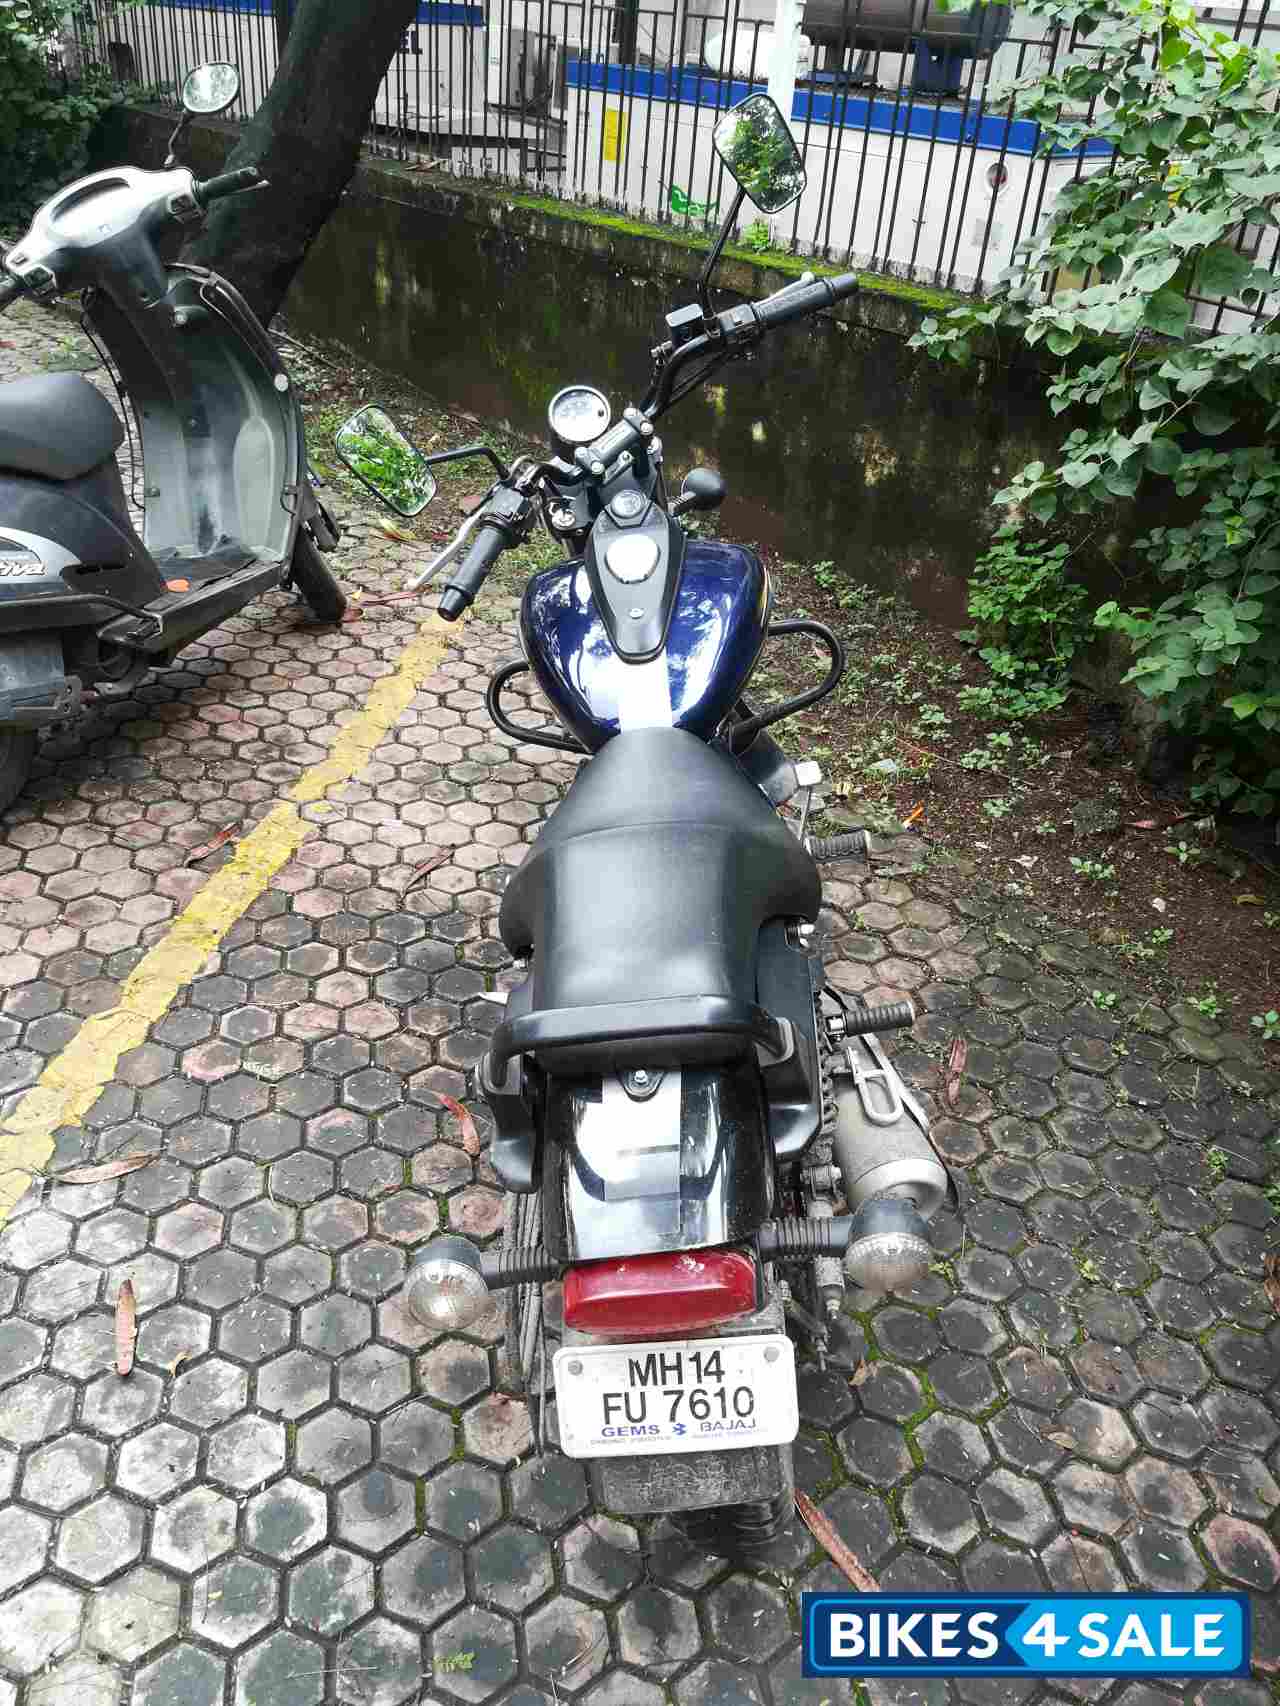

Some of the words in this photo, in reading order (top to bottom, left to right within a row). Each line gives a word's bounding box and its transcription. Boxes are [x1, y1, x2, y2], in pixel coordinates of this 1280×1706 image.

[603, 1391, 647, 1424] FU
[663, 1386, 754, 1422] 7610
[601, 1424, 661, 1437] GEMS
[700, 1418, 756, 1432] BAJAJ
